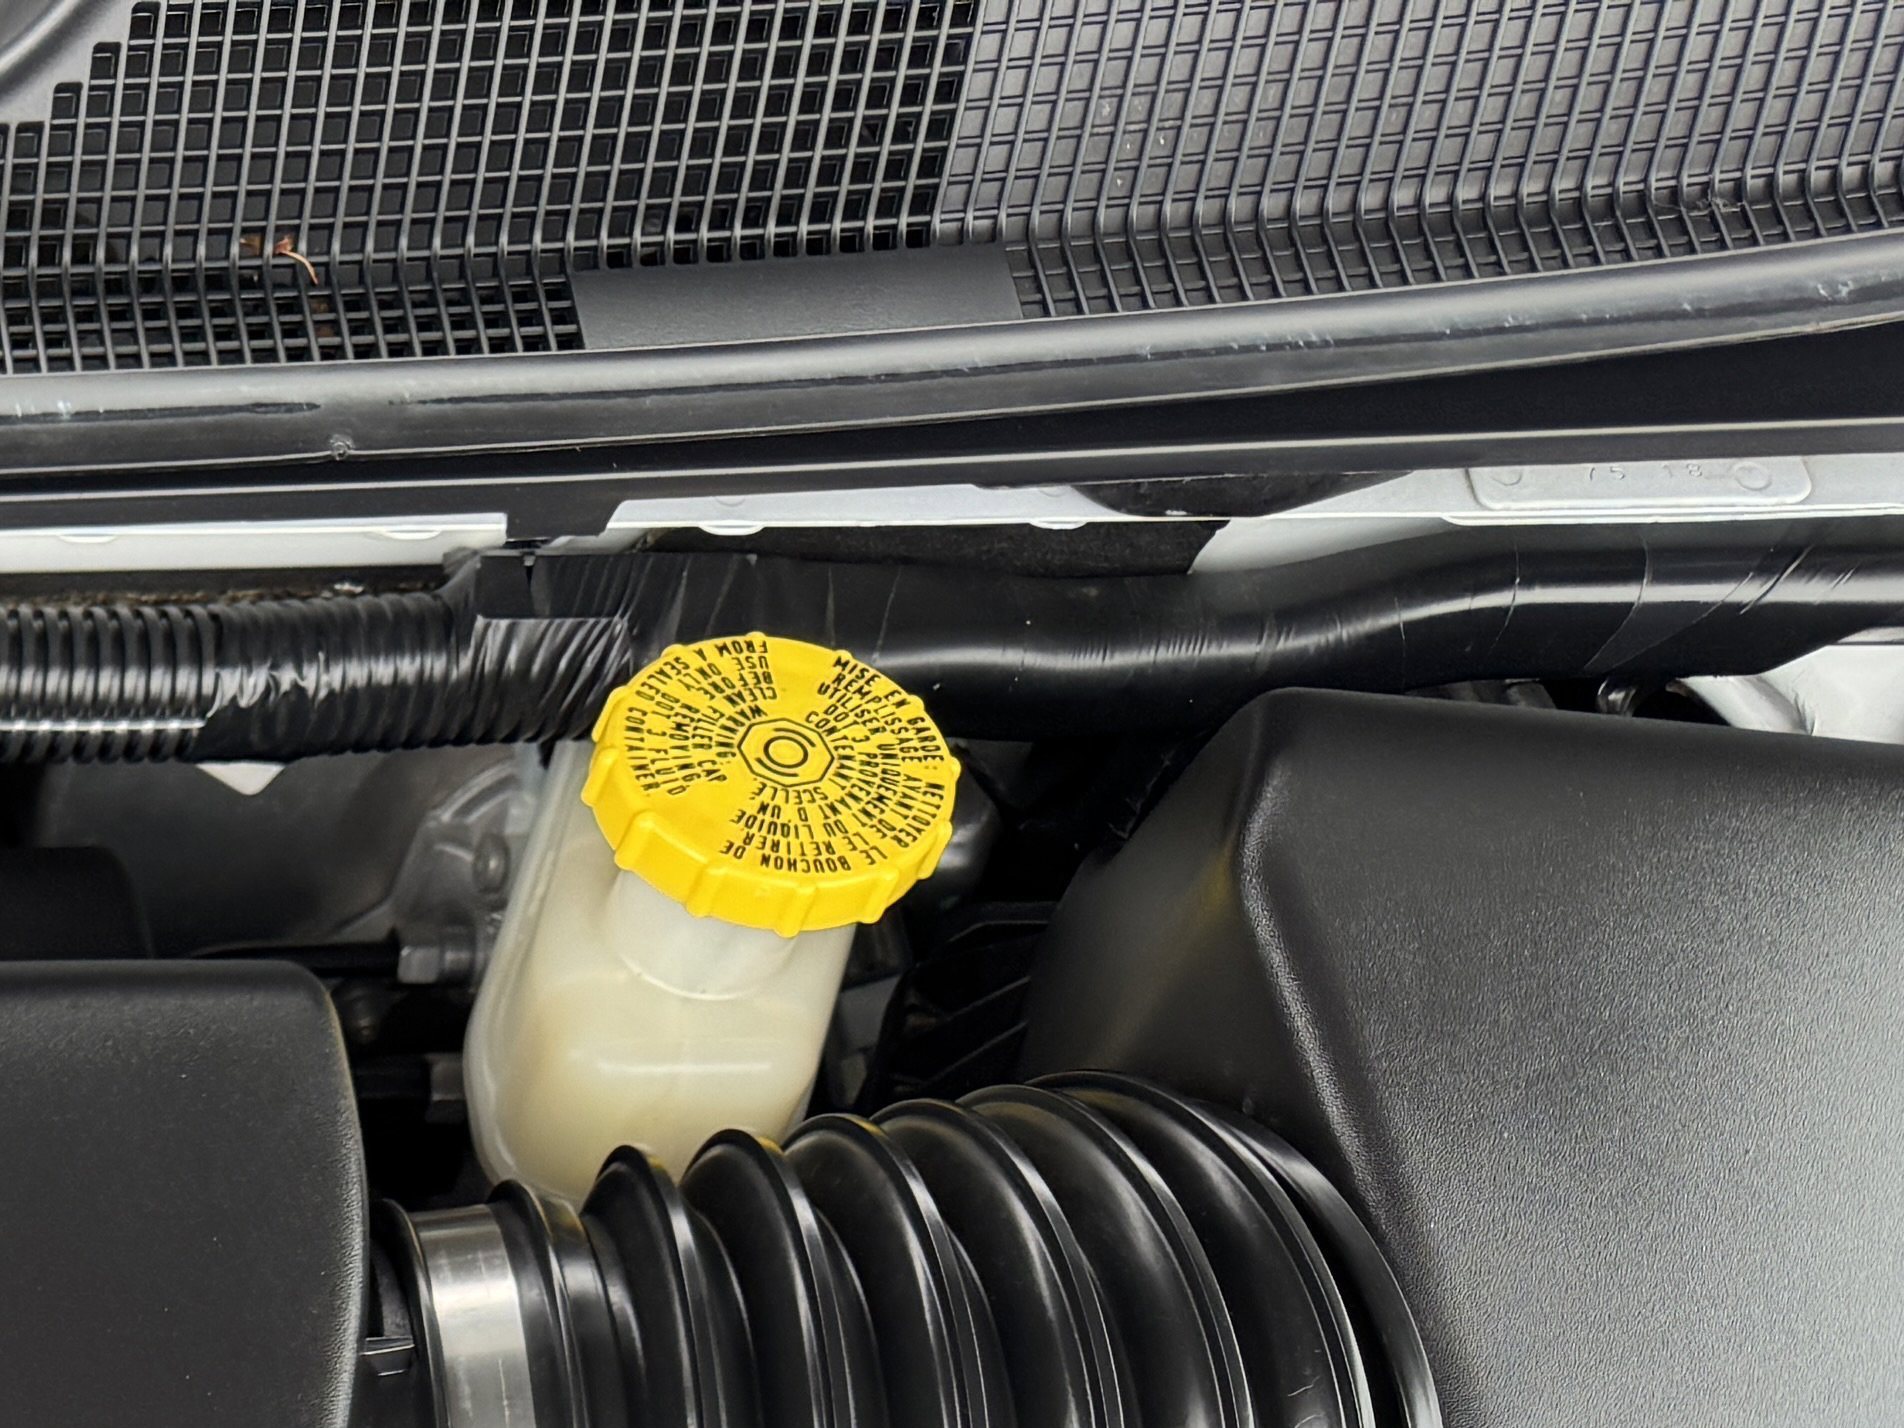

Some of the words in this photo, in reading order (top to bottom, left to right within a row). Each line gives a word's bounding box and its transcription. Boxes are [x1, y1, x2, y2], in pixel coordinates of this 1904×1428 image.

[693, 647, 708, 662] A
[715, 640, 768, 657] FROM
[731, 655, 769, 671] USE
[635, 656, 691, 701] SEALED
[677, 662, 722, 692] ONLY
[832, 656, 881, 686] MISE
[696, 671, 774, 701] BEFORE
[723, 686, 778, 708] CLEAN
[883, 689, 911, 709] EN
[651, 692, 681, 720] DOT
[817, 682, 887, 735] UTILISER
[823, 703, 860, 733] DOT
[832, 673, 923, 763] REMPLISSAGE
[646, 728, 667, 738] 3
[692, 705, 726, 750] FILLER
[850, 734, 871, 744] 3
[805, 711, 857, 790] CONTENANT
[906, 716, 945, 770] GARDE:
[647, 747, 687, 796] FLUID
[697, 759, 728, 783] CAP
[818, 751, 880, 820] PROVENANT
[851, 743, 901, 828] UNIQUEMENT
[729, 808, 815, 840] LIQUIDE
[823, 818, 849, 838] DU
[868, 818, 897, 840] DE
[890, 782, 945, 849] NETTOYER
[720, 839, 747, 860] DE
[841, 832, 870, 851] LE
[859, 845, 888, 866] LE
[760, 852, 852, 873] BOUCHON
